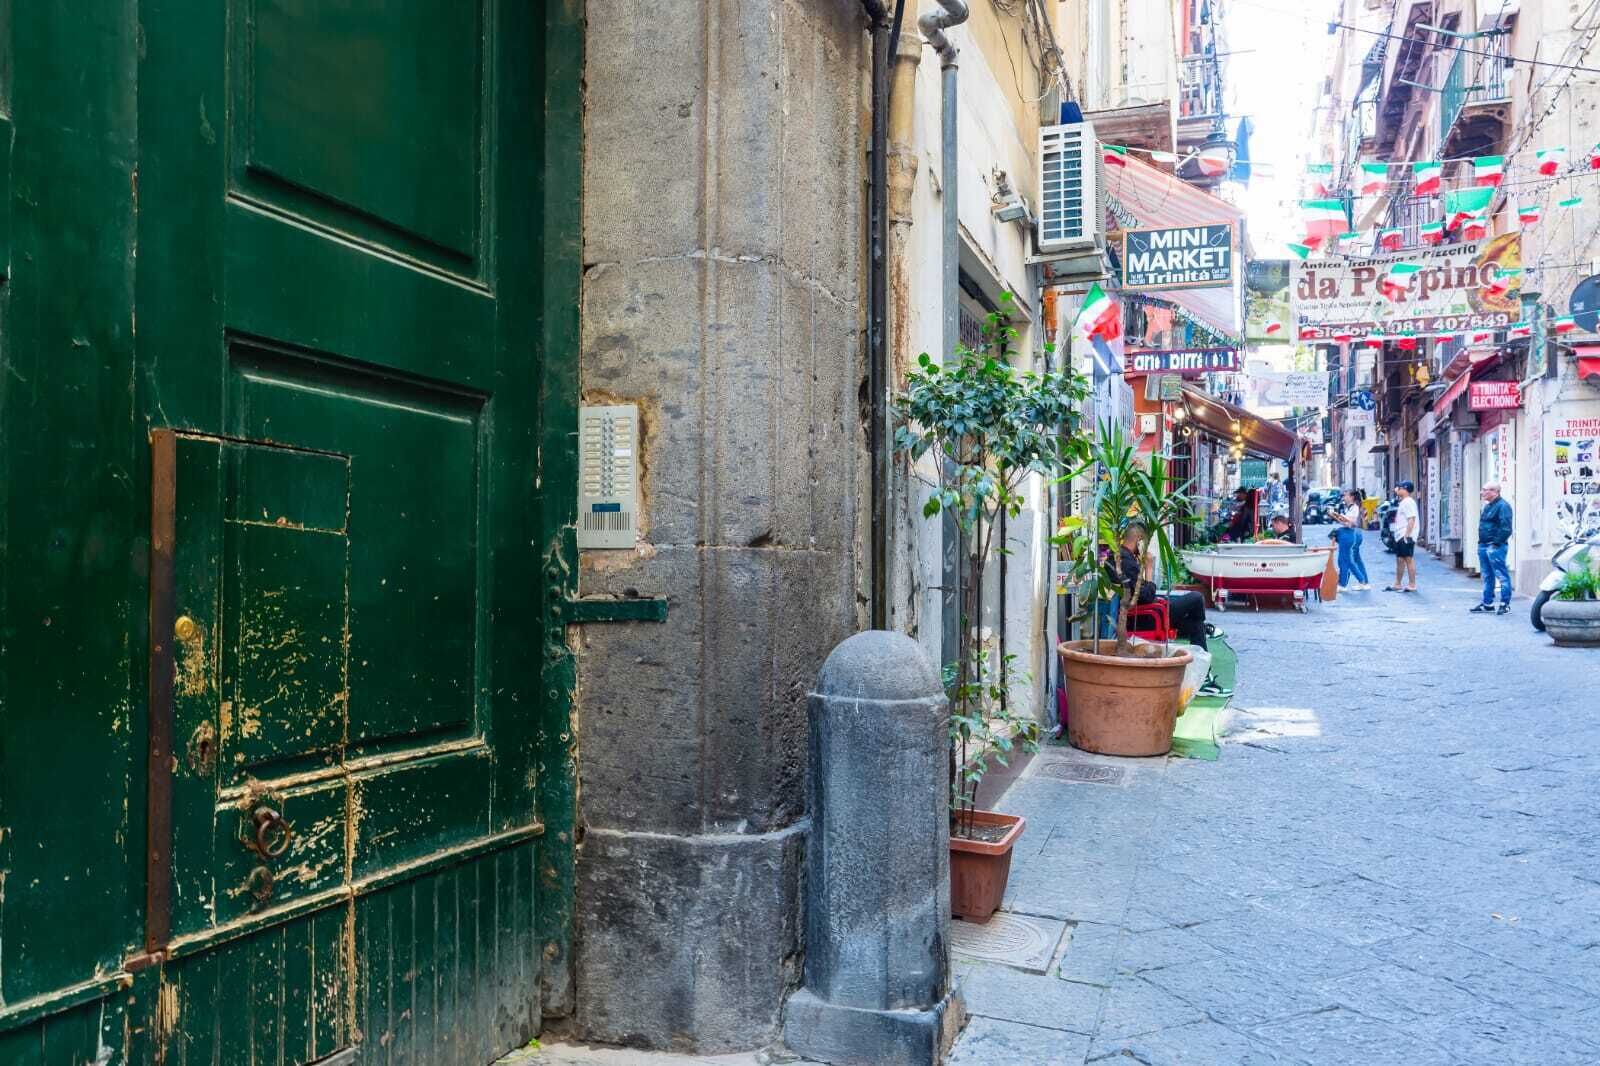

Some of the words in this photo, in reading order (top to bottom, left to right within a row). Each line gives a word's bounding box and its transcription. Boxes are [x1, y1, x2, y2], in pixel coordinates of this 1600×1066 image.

[1150, 228, 1208, 249] MINI
[1129, 247, 1230, 273] MARKET
[1300, 261, 1341, 269] Antica
[1422, 244, 1477, 259] Pizzeria
[1297, 270, 1338, 300] da
[1471, 394, 1519, 408] ELECTRONIC
[1555, 428, 1600, 437] ELECTRO
